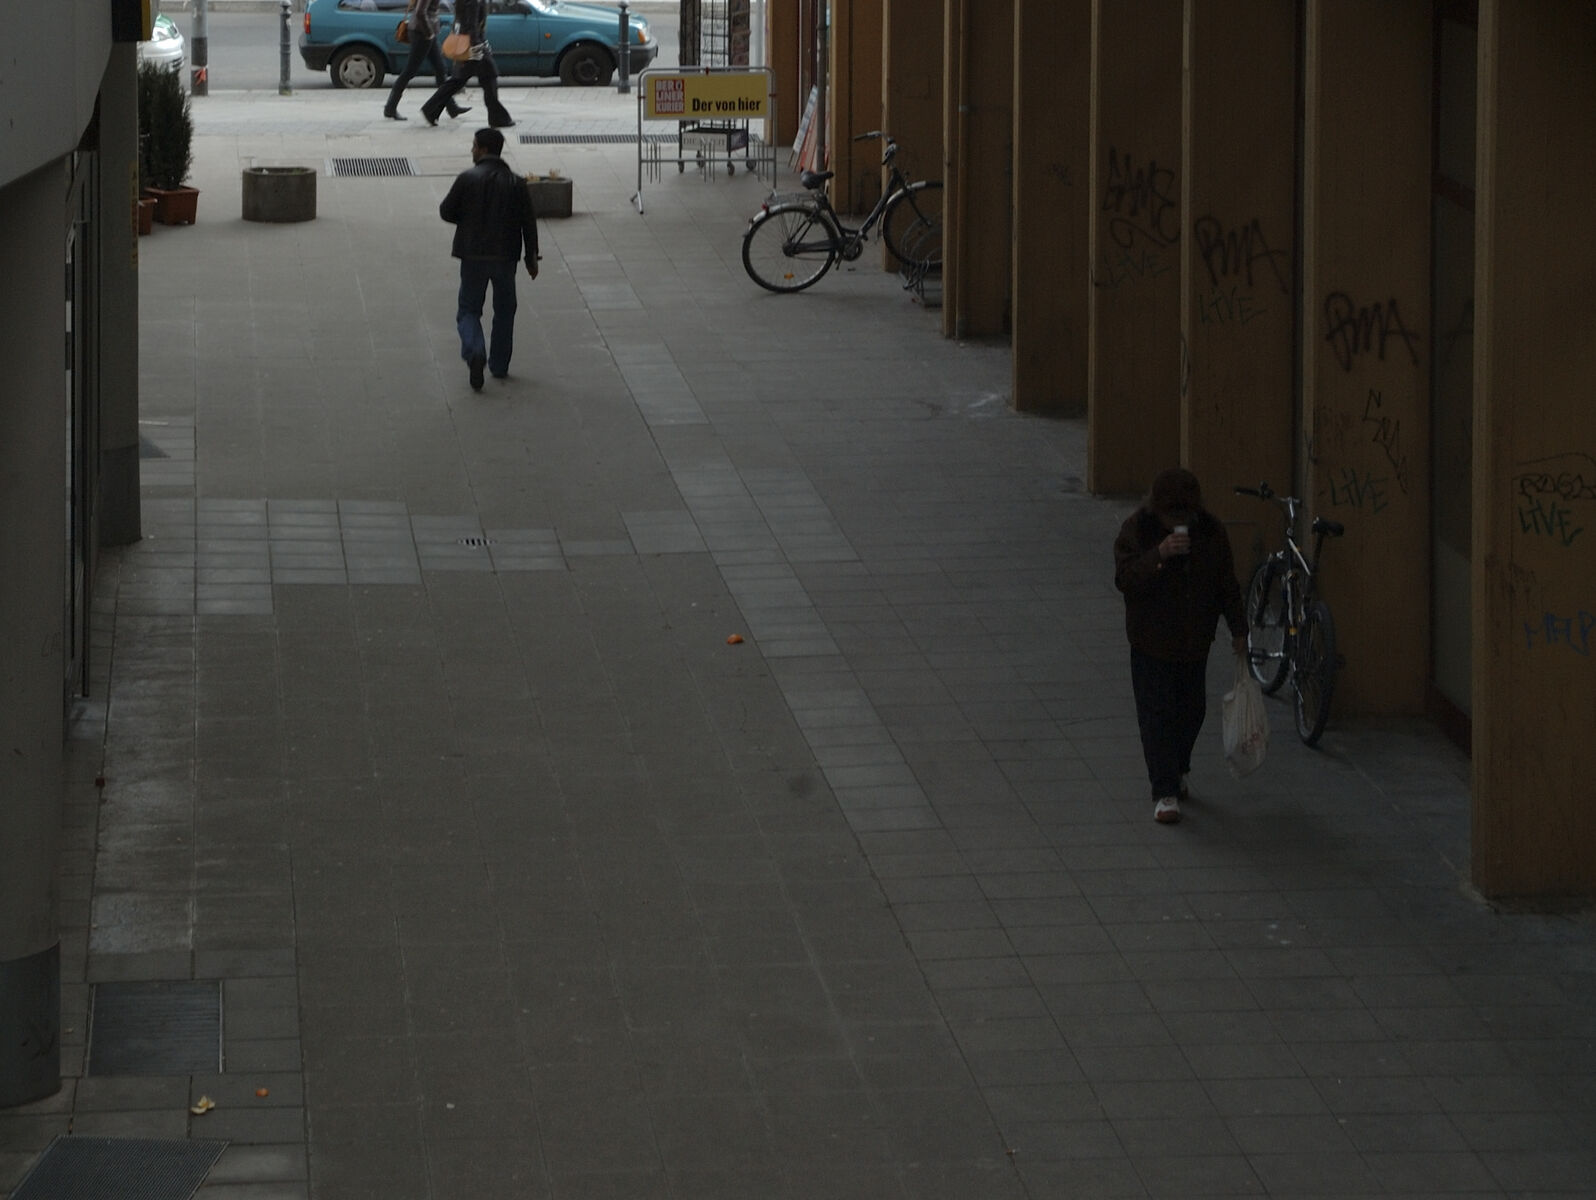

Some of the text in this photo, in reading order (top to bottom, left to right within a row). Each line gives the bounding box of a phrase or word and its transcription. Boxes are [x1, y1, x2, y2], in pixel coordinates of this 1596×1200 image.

[692, 97, 761, 111] Der von hier
[1328, 467, 1389, 514] LIVE
[1518, 498, 1584, 547] LIVE
